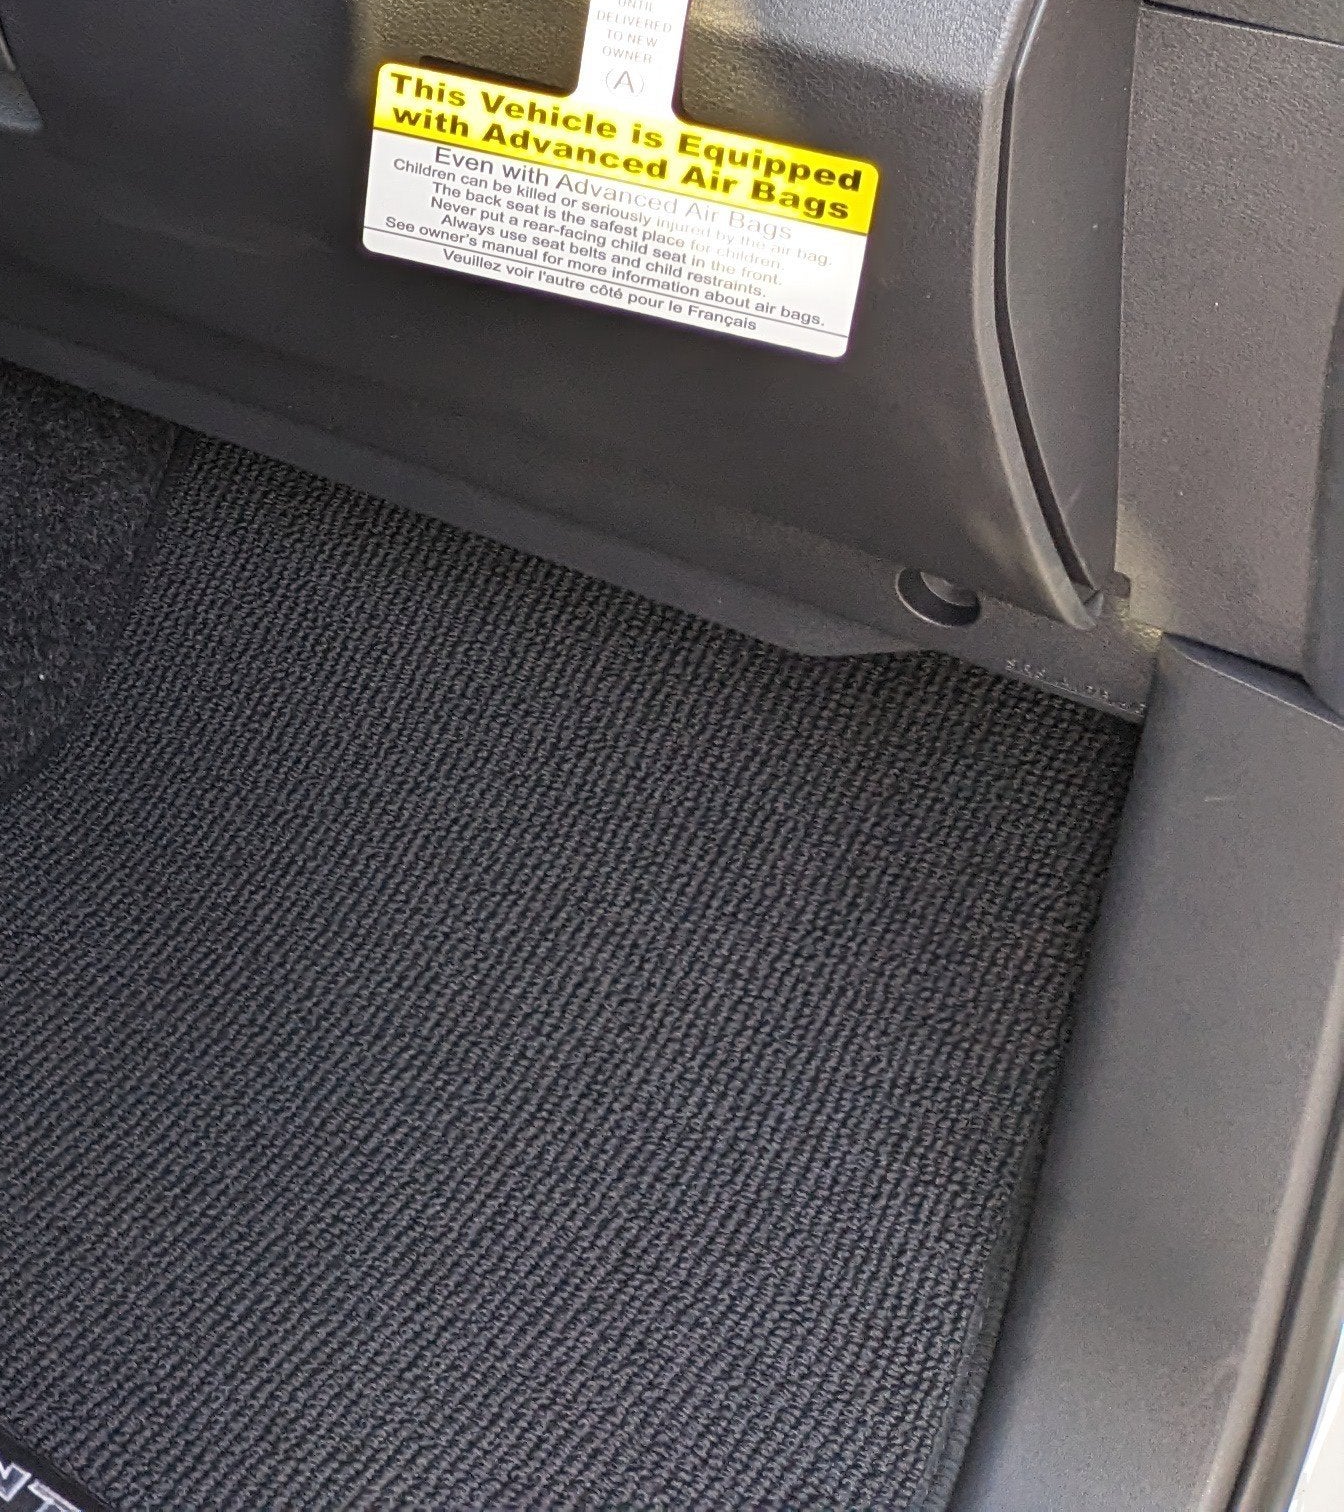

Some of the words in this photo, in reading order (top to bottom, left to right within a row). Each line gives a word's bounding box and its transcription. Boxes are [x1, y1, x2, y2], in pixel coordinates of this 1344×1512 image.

[596, 9, 672, 34] DELIVERED
[601, 45, 654, 65] OWNER
[607, 28, 623, 42] TO
[627, 32, 659, 48] NEW
[605, 68, 645, 95] (A)
[390, 71, 467, 107] This
[480, 90, 618, 139] Vehicle
[631, 122, 664, 149] is
[678, 132, 863, 193] Equipped
[392, 106, 470, 138] with
[481, 122, 668, 180] Advanced
[680, 165, 739, 194] Air
[750, 179, 850, 220] Bags
[393, 157, 456, 182] Children
[461, 174, 489, 189] can
[493, 179, 512, 194] be
[516, 185, 557, 205] killed
[561, 196, 579, 209] or
[581, 200, 652, 228] seriously
[656, 217, 711, 239] injured
[715, 228, 735, 245] by
[739, 234, 765, 251] the
[770, 241, 791, 256] air
[796, 248, 833, 268] bag.
[432, 181, 462, 199] The
[466, 188, 503, 208] back
[506, 199, 540, 216] seat
[543, 205, 557, 219] is
[561, 210, 586, 226] the
[590, 219, 639, 237] safest
[642, 228, 686, 248] place
[690, 239, 711, 254] for
[716, 246, 785, 271] children.
[434, 145, 494, 175] Even
[502, 163, 550, 187] with
[555, 173, 678, 214] Advanced
[685, 201, 720, 223] Air
[728, 209, 793, 240] Bags
[384, 215, 415, 233] See
[418, 225, 478, 247] owner's
[481, 240, 539, 261] manual
[542, 251, 563, 267] for
[566, 259, 608, 276] more
[611, 266, 700, 298] information
[704, 288, 751, 310] about
[754, 299, 777, 315] air
[780, 304, 826, 327] bags.
[430, 195, 477, 217] Never
[480, 208, 506, 224] put
[508, 215, 519, 226] a
[522, 217, 608, 248] rear-facing
[611, 237, 649, 255] child
[652, 247, 688, 264] seat
[691, 254, 706, 268] in
[711, 259, 736, 275] the
[741, 267, 783, 286] front.
[440, 213, 496, 238] Always
[499, 229, 528, 243] use
[531, 236, 566, 251] seat
[569, 242, 608, 261] belts
[610, 253, 641, 269] and
[645, 260, 683, 278] child
[687, 271, 767, 299] restraints.
[442, 247, 502, 273] Veuillez
[505, 263, 535, 280] voir
[538, 269, 586, 291] l'autre
[589, 280, 624, 300] côté
[627, 291, 666, 310] pour
[668, 299, 683, 313] le
[686, 304, 758, 331] Français
